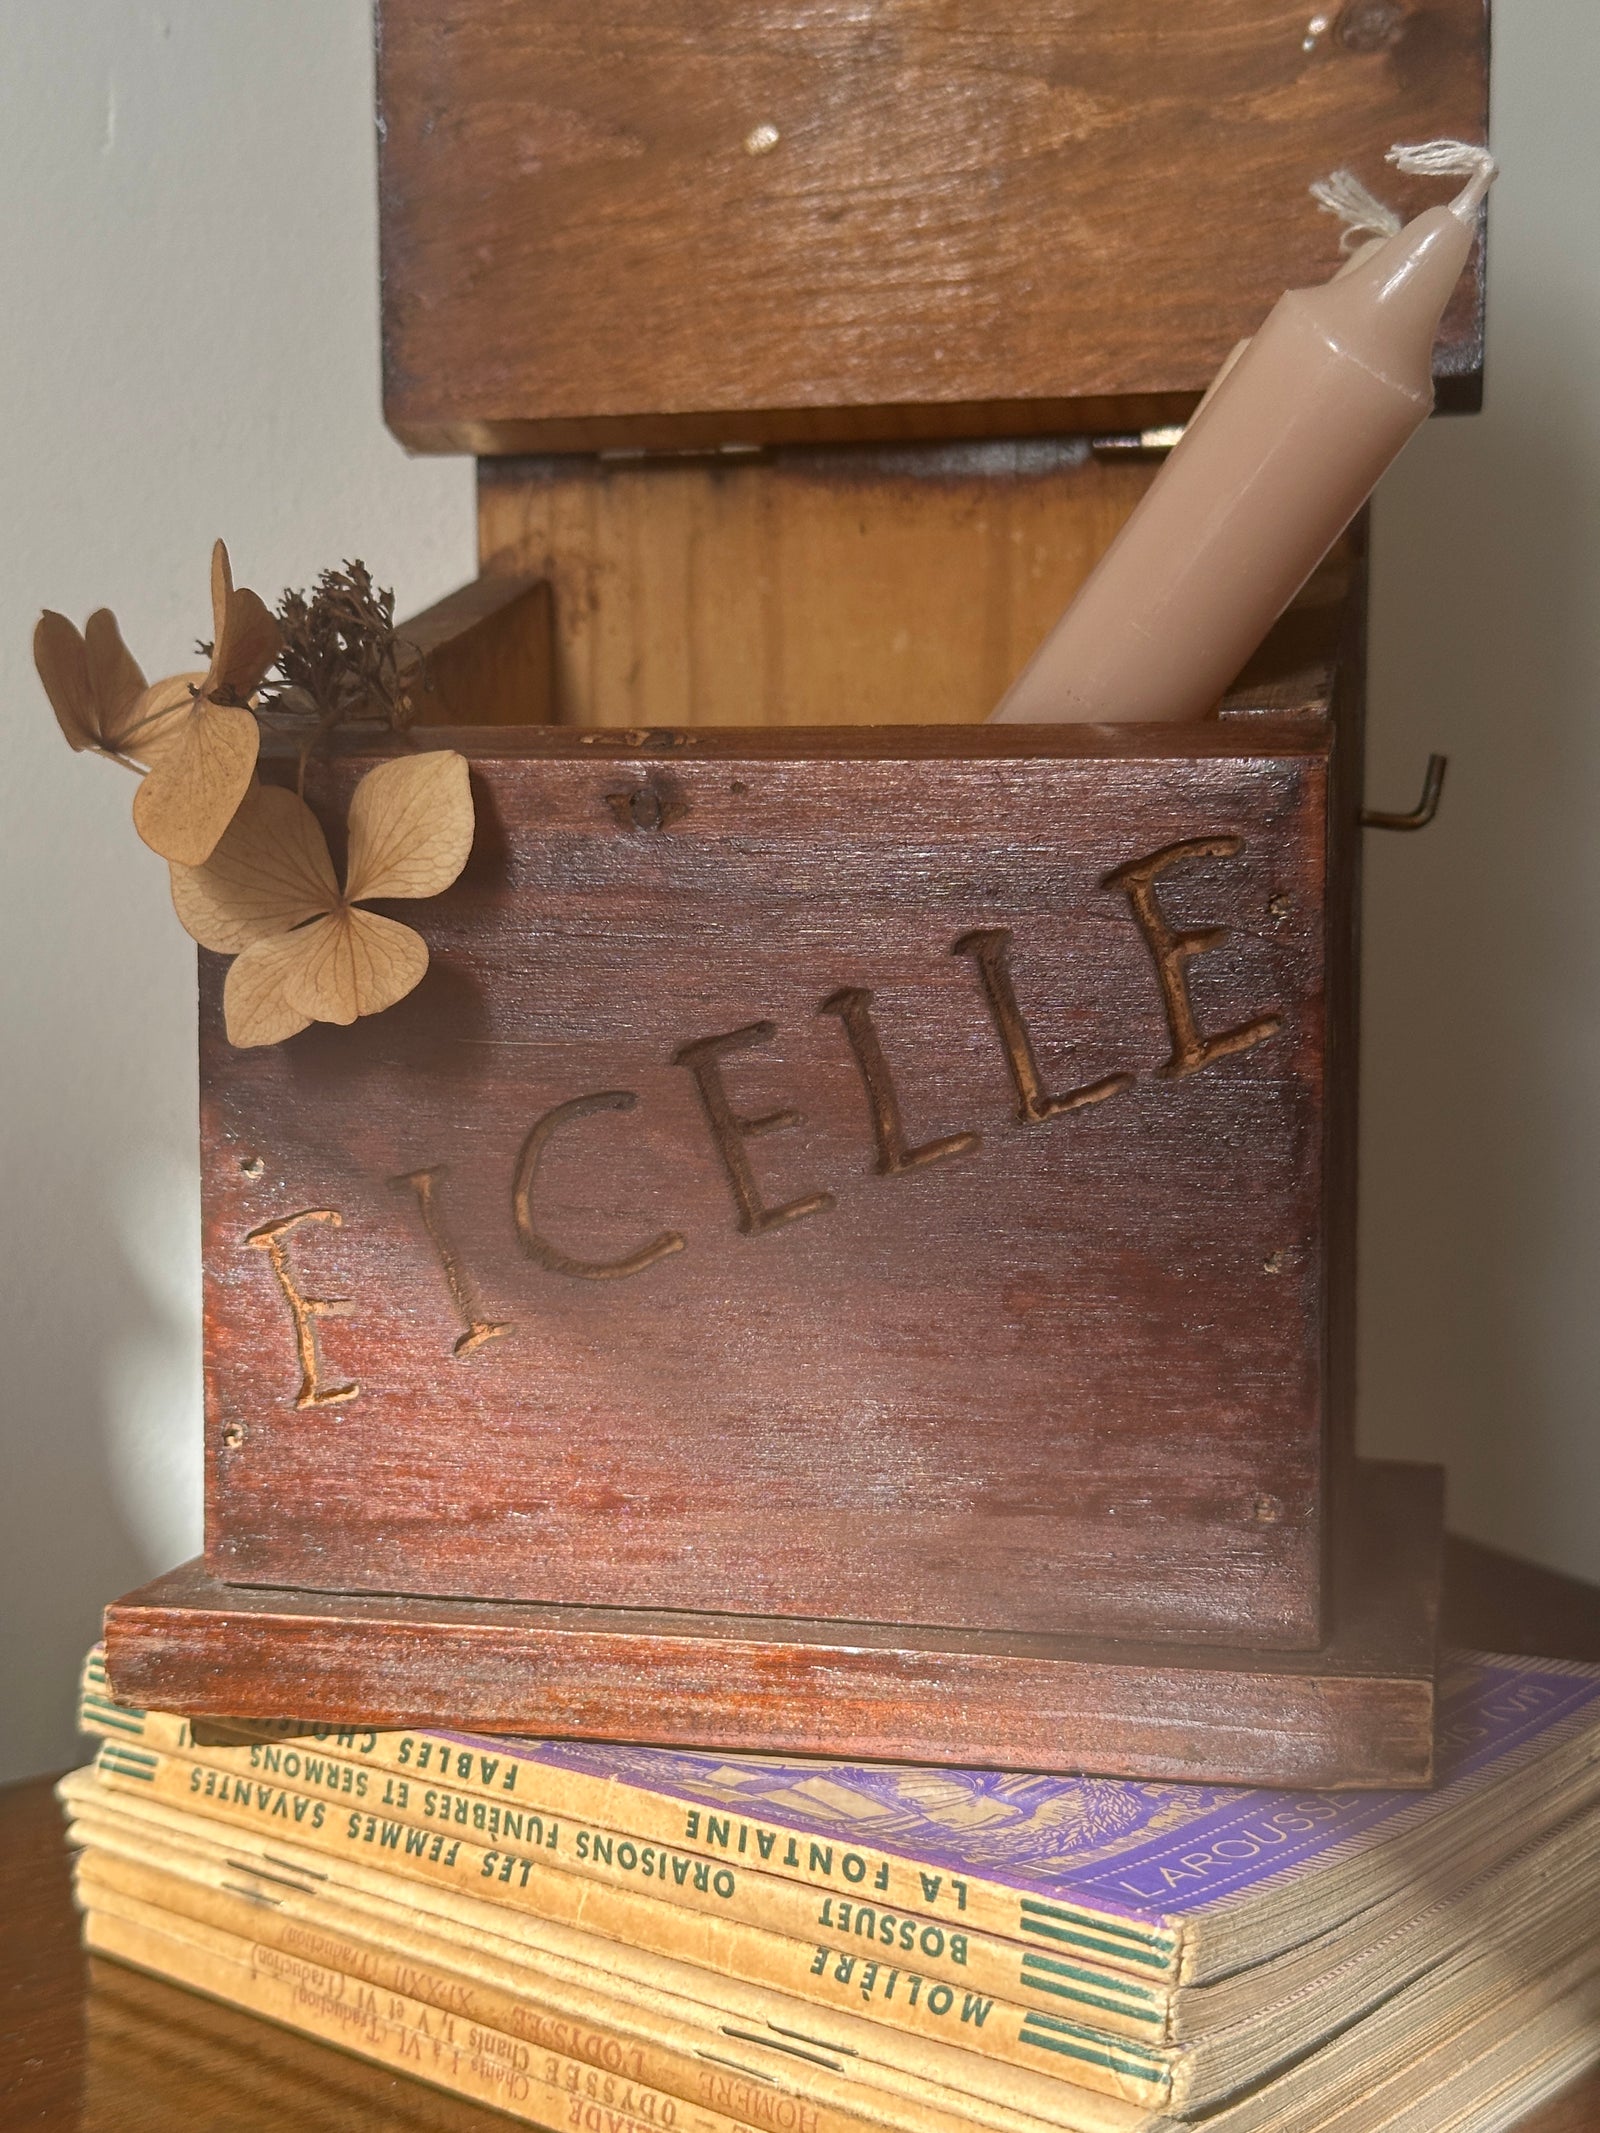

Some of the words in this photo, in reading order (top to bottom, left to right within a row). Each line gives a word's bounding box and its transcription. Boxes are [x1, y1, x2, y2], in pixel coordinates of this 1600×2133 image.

[249, 1743, 369, 1797] SERMONS
[398, 1736, 519, 1791] FABLES
[189, 1767, 327, 1829] SAVANTES
[381, 1778, 410, 1809] ET
[423, 1789, 559, 1850] FUNÈBRES
[346, 1812, 462, 1867] FEMMES
[575, 1830, 736, 1899] ORAISONS
[684, 1809, 890, 1891] FONTAINE
[1118, 1792, 1361, 1900] LAROUSSE
[480, 1850, 534, 1888] LES
[918, 1871, 968, 1911] LA
[817, 1897, 969, 1966] BOSSUET
[358, 1986, 377, 2015] VI
[388, 1997, 406, 2020] et
[810, 1945, 995, 2029] MOLIÈRE
[418, 2009, 430, 2035] V
[468, 2027, 530, 2072] Chants
[471, 2056, 530, 2101] Chants
